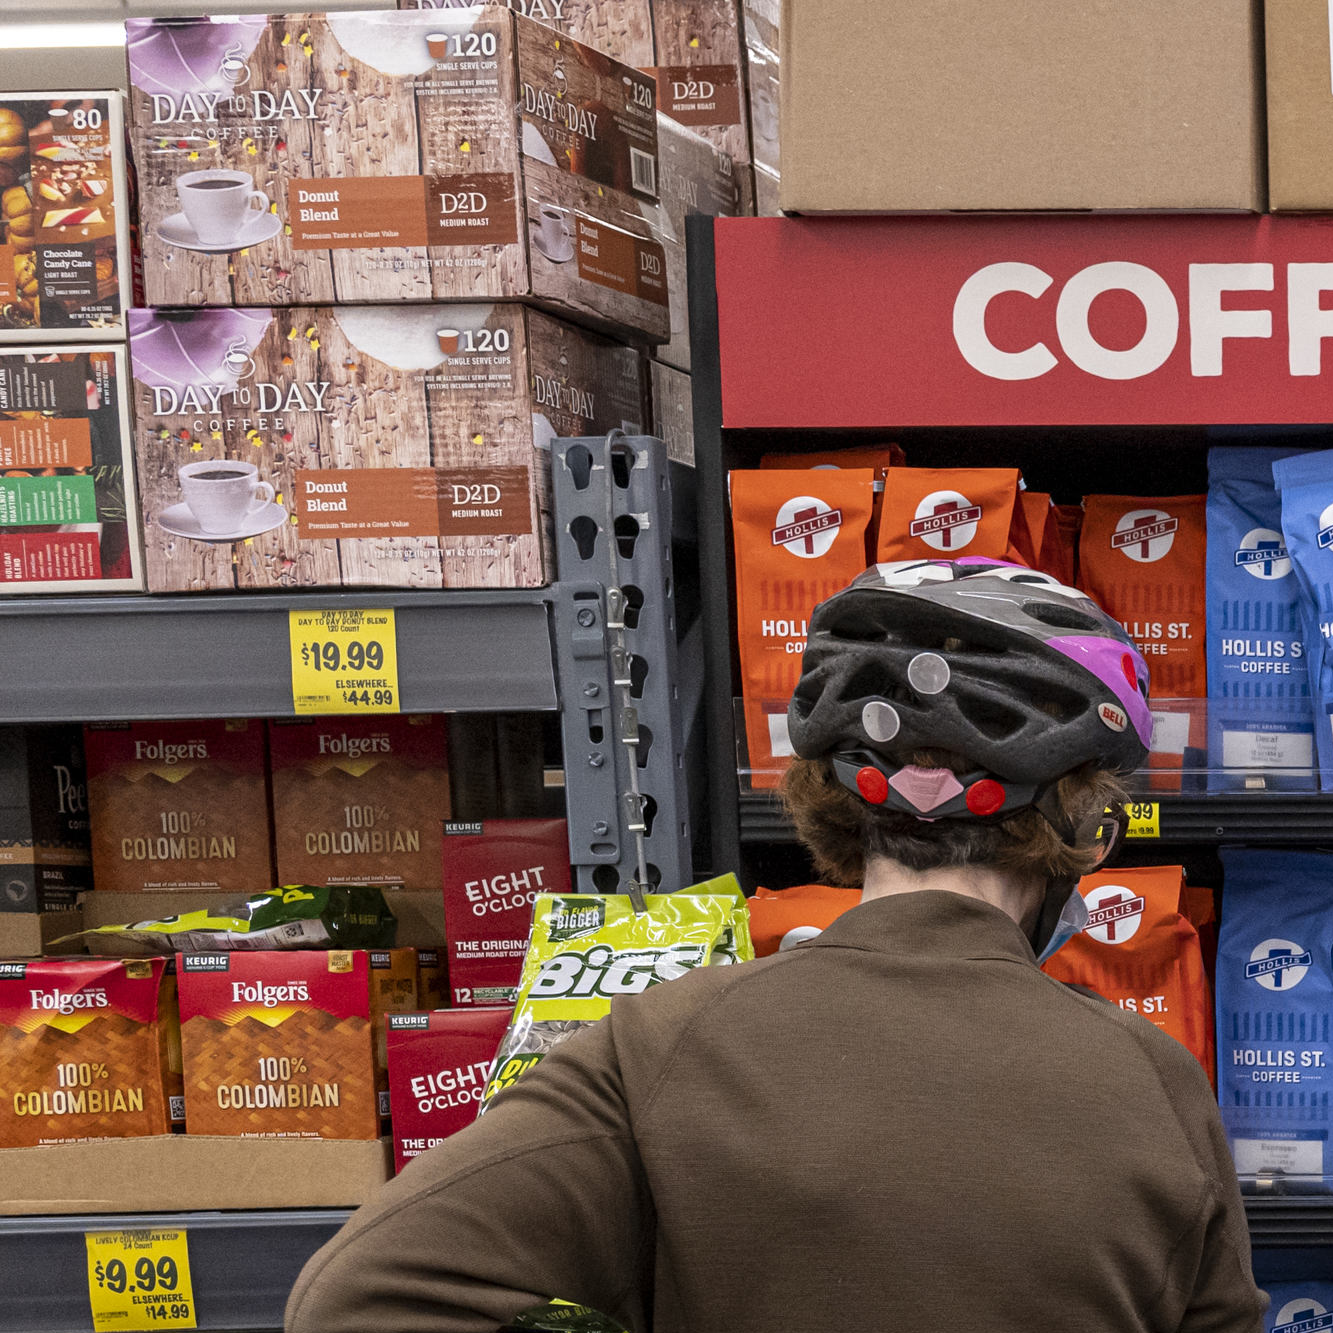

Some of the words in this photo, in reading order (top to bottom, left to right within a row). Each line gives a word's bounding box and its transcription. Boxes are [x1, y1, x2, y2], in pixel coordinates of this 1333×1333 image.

[452, 33, 496, 57] 120
[436, 62, 457, 71] SINGLE
[460, 62, 478, 70] SERVE
[481, 61, 497, 70] CUPS
[152, 92, 219, 124] DAY
[228, 97, 245, 112] TO
[252, 89, 322, 120] DAY
[73, 109, 101, 129] 80
[192, 126, 278, 140] COFFEE
[298, 190, 339, 204] Donut
[440, 192, 487, 214] D2D
[300, 208, 339, 222] Blend
[440, 219, 467, 227] MEDIUM
[469, 218, 489, 227] ROAST
[44, 250, 82, 258] Chocolate
[44, 260, 70, 269] Candy
[72, 260, 92, 268] Cane
[153, 385, 222, 416] DAY
[233, 389, 250, 405] TO
[256, 382, 330, 413] DAY
[194, 418, 284, 432] COFFEE
[306, 480, 348, 494] Donut
[307, 498, 347, 512] Blend
[781, 518, 829, 539] HOLLIS
[301, 641, 384, 671] $19.99
[343, 690, 392, 705] $44.99
[1103, 706, 1123, 728] BELL
[465, 866, 544, 902] EIGHT
[186, 956, 228, 966] KEURIG
[30, 989, 108, 1014] Folgers
[232, 981, 309, 1007] Folgers
[57, 1063, 108, 1088] 100%
[258, 1056, 307, 1081] 100%
[14, 1088, 144, 1116] COLOMBIAN
[217, 1083, 339, 1109] COLOMBIAN
[95, 1256, 178, 1294] $9.99
[146, 1304, 189, 1320] $14.99
